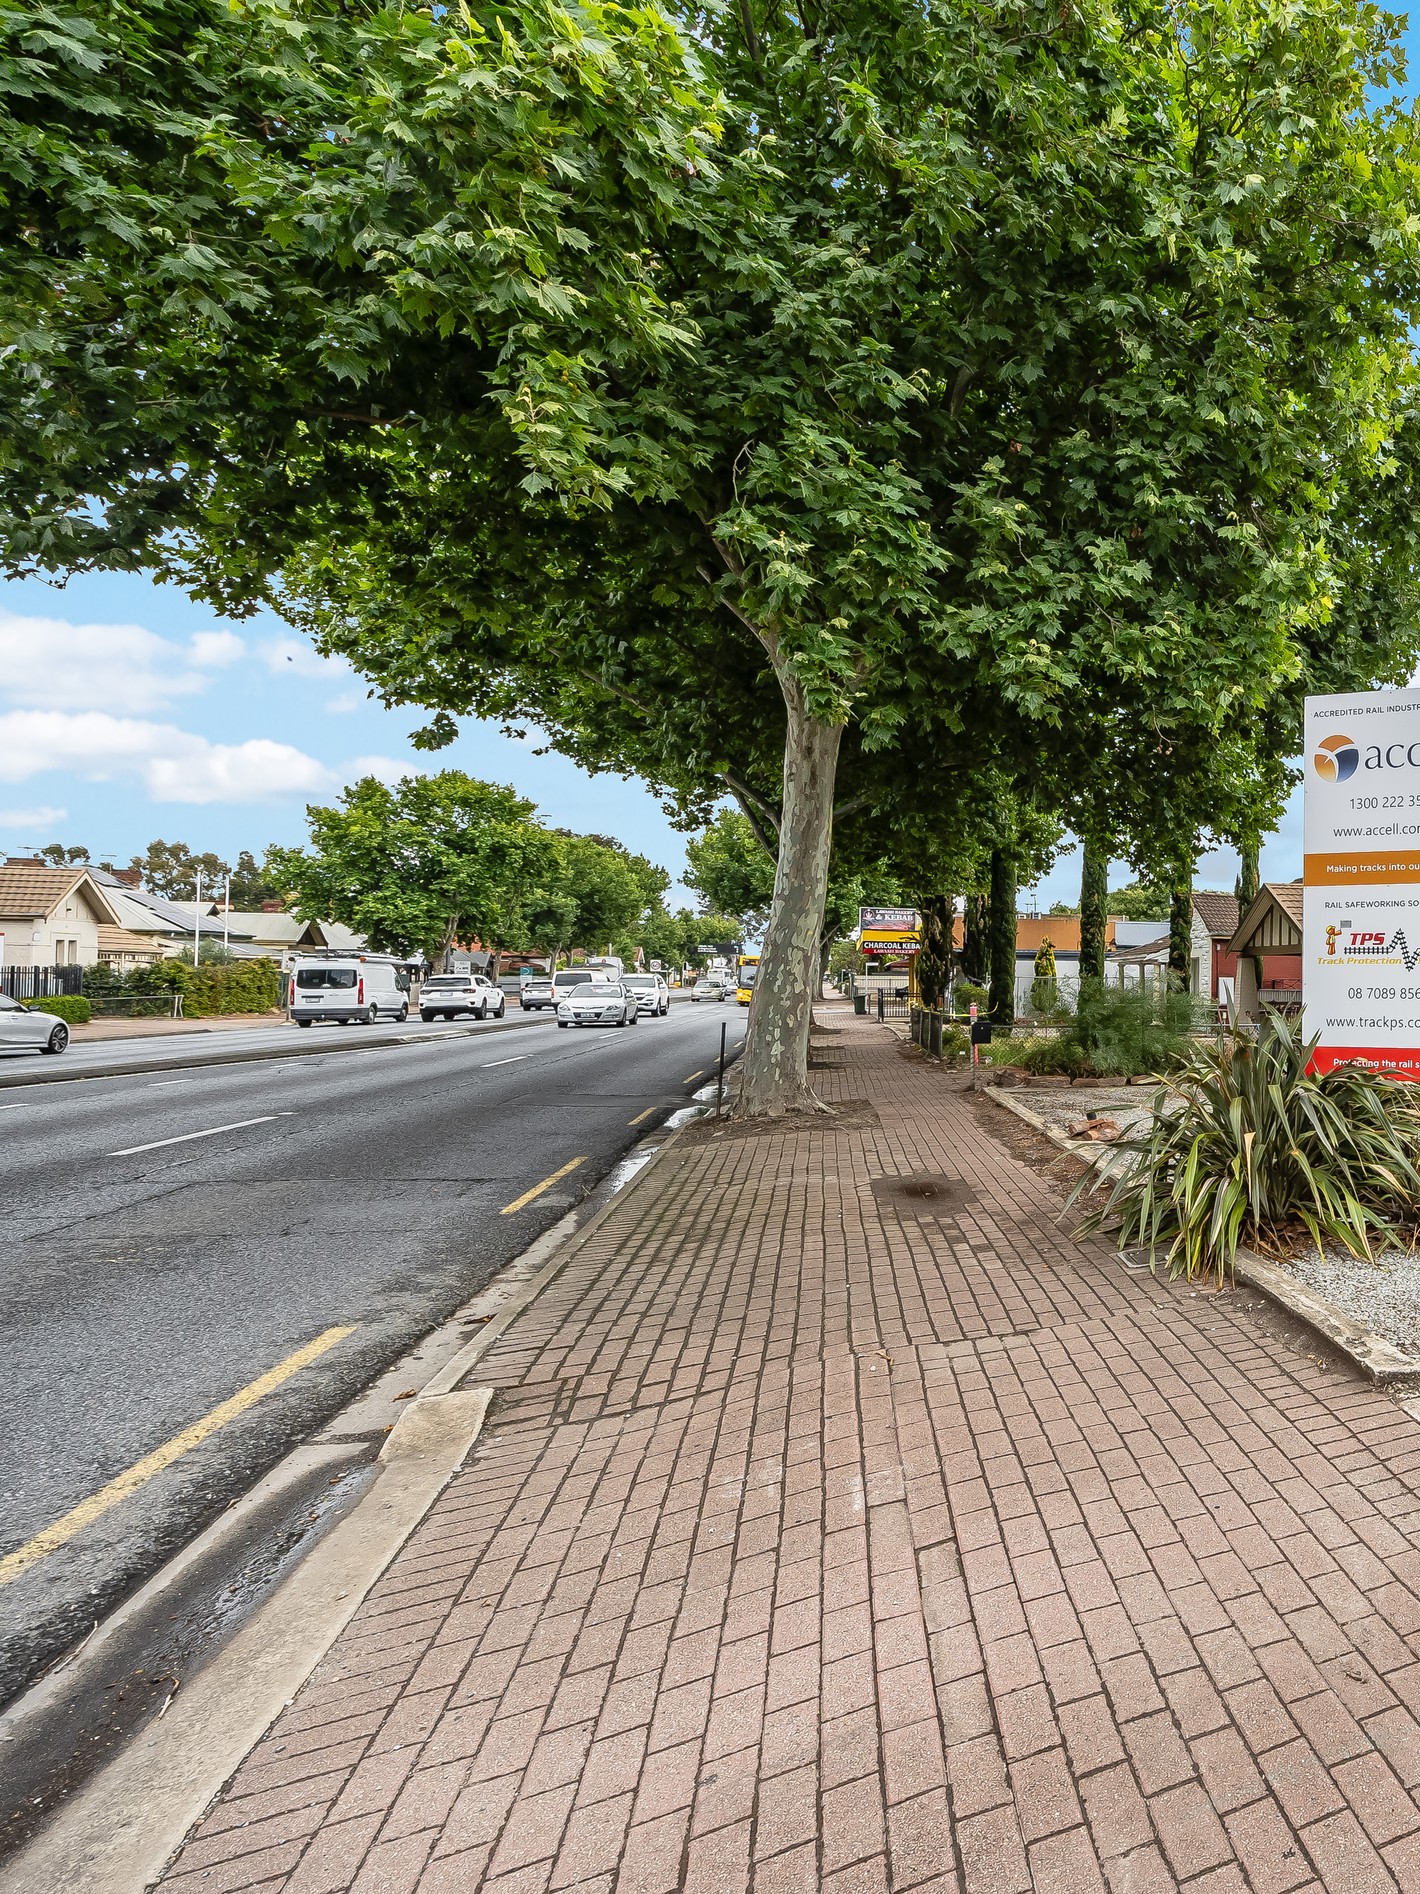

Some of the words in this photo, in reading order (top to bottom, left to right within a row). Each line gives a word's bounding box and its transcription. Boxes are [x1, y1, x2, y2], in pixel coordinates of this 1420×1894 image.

[1313, 708, 1364, 718] ACCREDITED
[1366, 707, 1384, 715] RAIL
[1349, 797, 1378, 810] 1300
[1382, 796, 1404, 809] 222
[1326, 864, 1358, 874] Making
[1360, 863, 1386, 872] tracks
[1388, 863, 1406, 871] into
[1324, 901, 1343, 909] RAIL
[1345, 900, 1406, 908] SAFEWORKING
[1350, 932, 1386, 946] TPS
[1317, 957, 1344, 965] Track
[1347, 957, 1402, 965] Protection
[1348, 987, 1363, 999] 08
[1367, 987, 1396, 999] 7089
[1333, 1058, 1379, 1069] Proecting
[1382, 1059, 1396, 1068] the
[1399, 1060, 1413, 1068] rail
